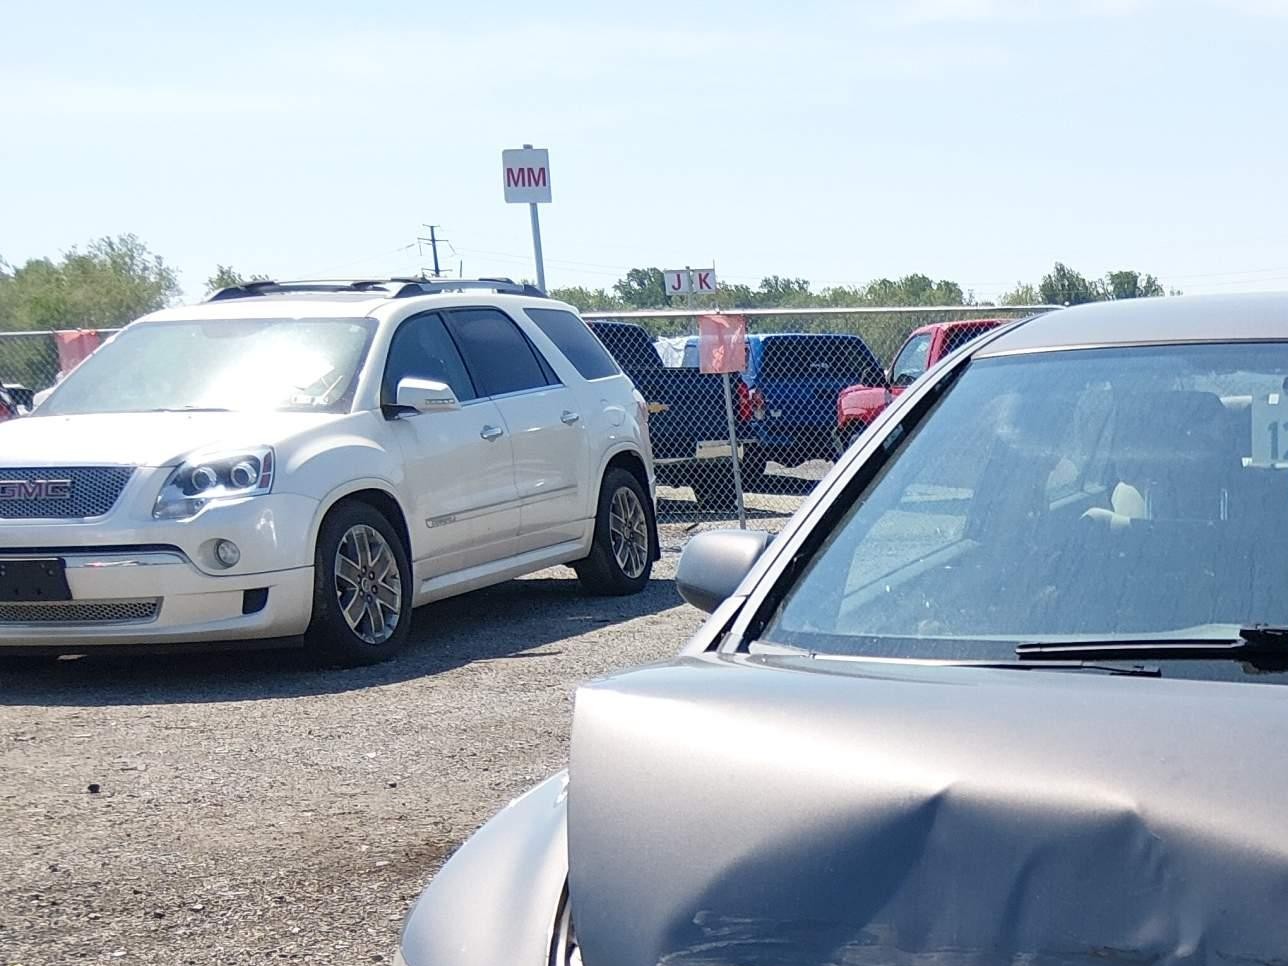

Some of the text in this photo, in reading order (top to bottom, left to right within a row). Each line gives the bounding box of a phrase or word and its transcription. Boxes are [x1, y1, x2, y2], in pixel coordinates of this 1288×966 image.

[506, 167, 547, 187] MM
[671, 273, 682, 291] J
[698, 272, 713, 290] K
[0, 480, 71, 499] GMC
